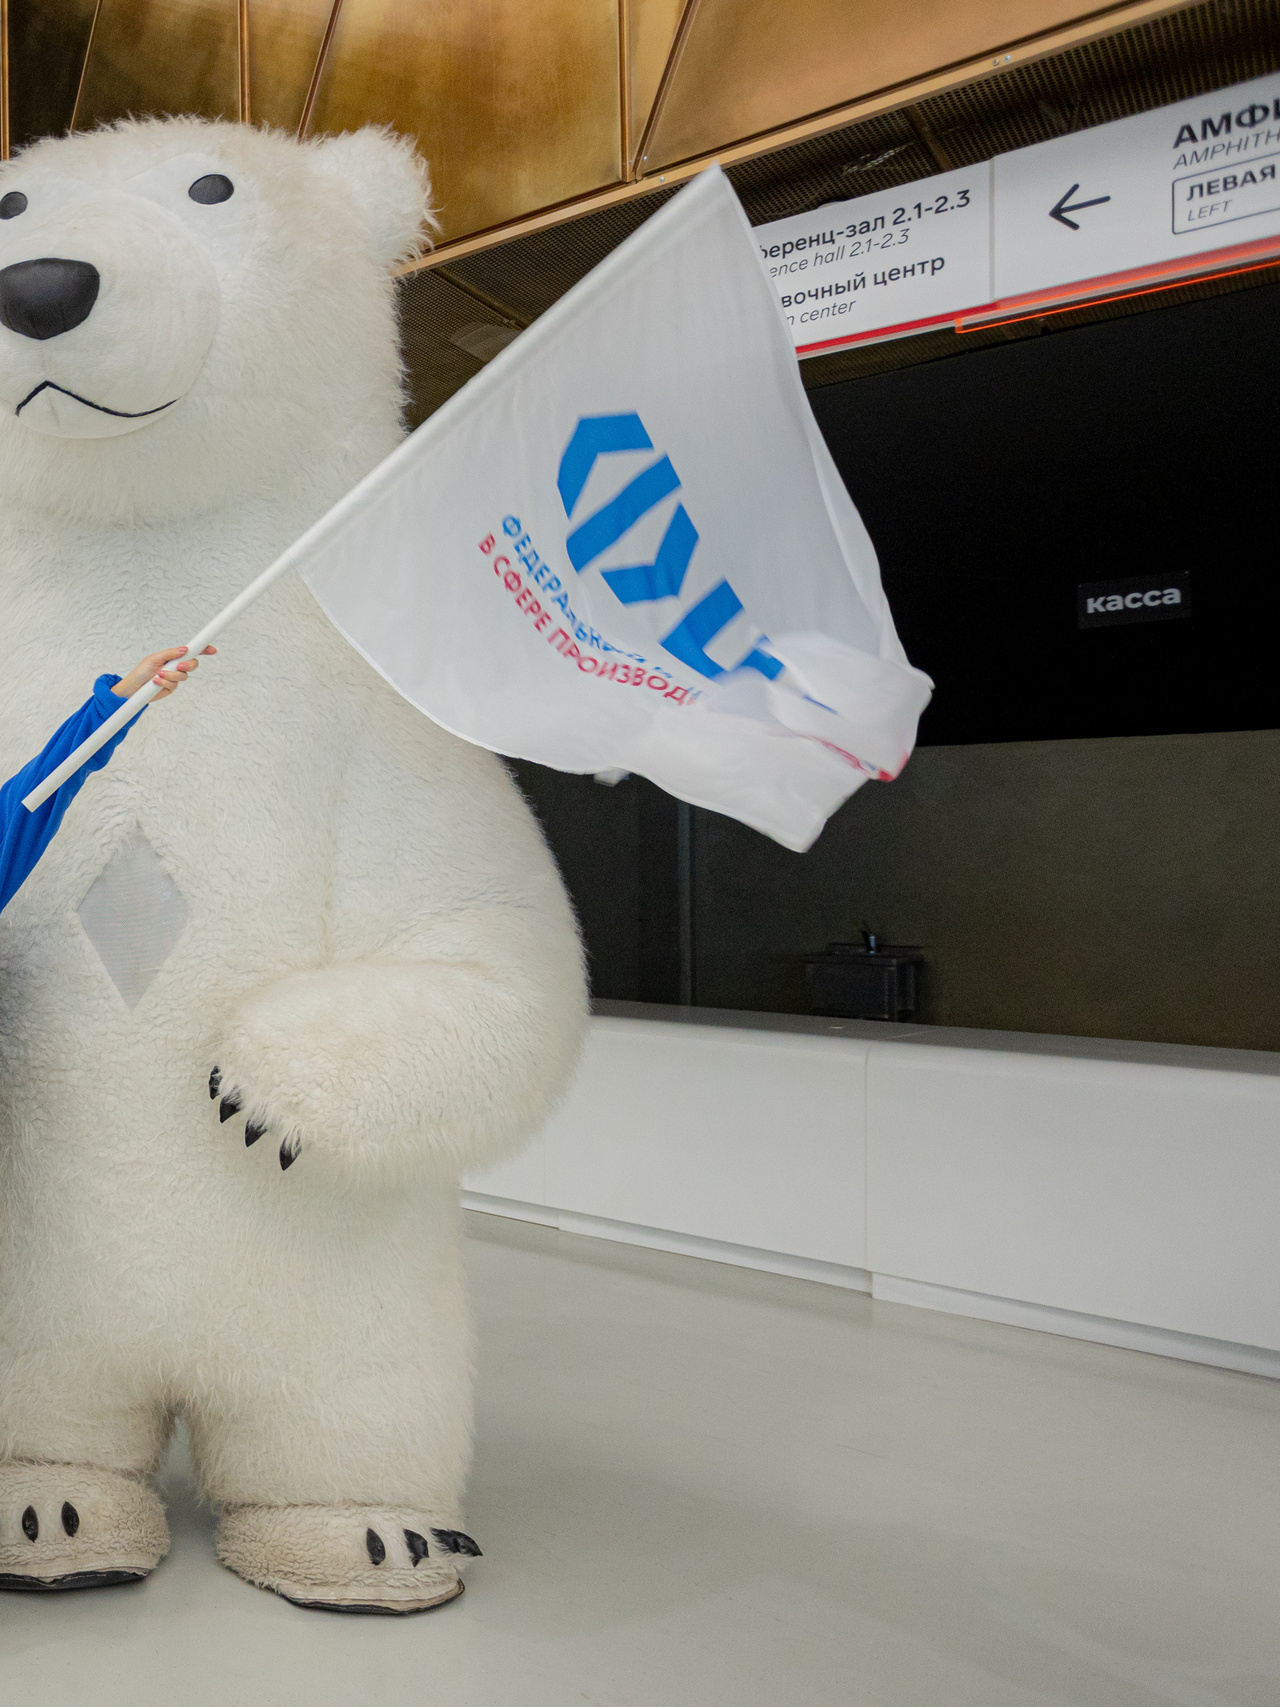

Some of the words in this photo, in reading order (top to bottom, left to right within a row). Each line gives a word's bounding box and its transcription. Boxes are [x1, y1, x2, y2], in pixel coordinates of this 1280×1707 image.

[1186, 164, 1276, 201] ЛЕВАЯ
[892, 189, 971, 226] 2.1-2.3
[1187, 199, 1233, 222] LEFT
[813, 245, 846, 267] hall
[849, 228, 911, 258] 2.1-2.3
[873, 256, 946, 286] центр
[800, 299, 857, 324] center
[478, 532, 496, 555] В
[493, 554, 553, 634] СФЕРЕ
[1086, 588, 1181, 614] касса
